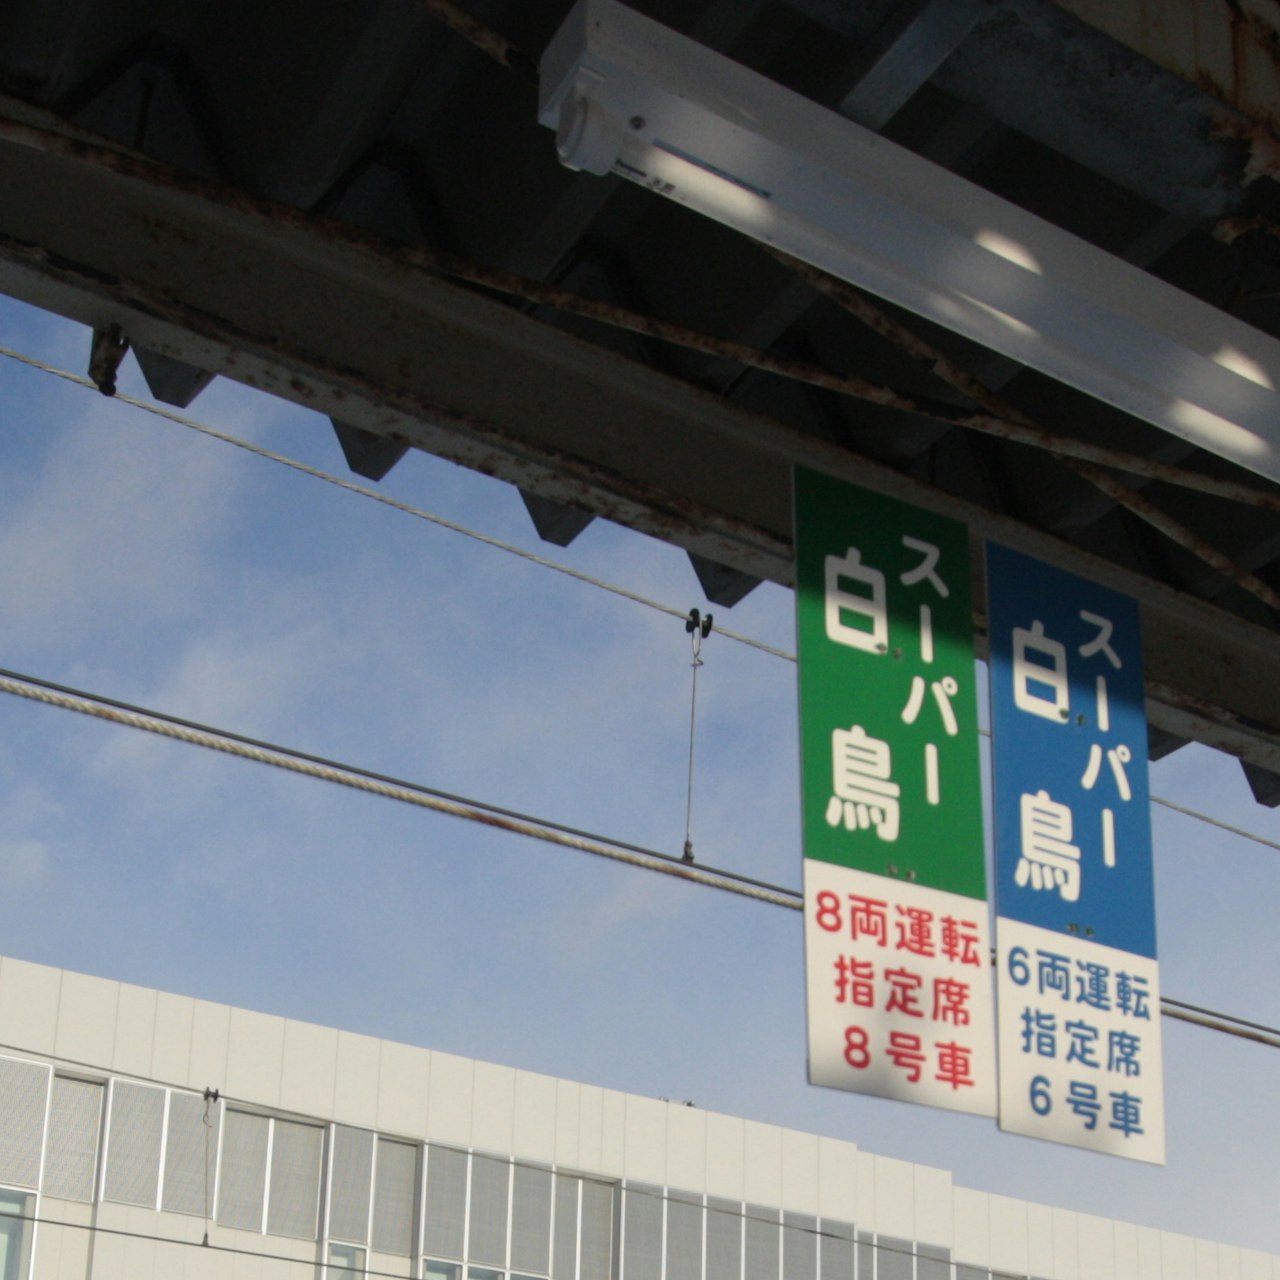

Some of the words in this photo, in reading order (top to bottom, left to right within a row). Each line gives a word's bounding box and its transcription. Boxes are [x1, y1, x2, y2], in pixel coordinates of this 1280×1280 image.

[824, 547, 901, 842] 白鳥
[900, 535, 959, 805] スーパー
[1012, 620, 1081, 902] 白鳥
[1078, 609, 1131, 867] スーパー
[815, 889, 981, 968] 8両運転
[833, 955, 971, 1028] 指定席
[1007, 946, 1151, 1022] 6両運転
[843, 1025, 975, 1091] 8号車
[1020, 1006, 1142, 1078] 指定席
[1029, 1075, 1144, 1139] 6号車
